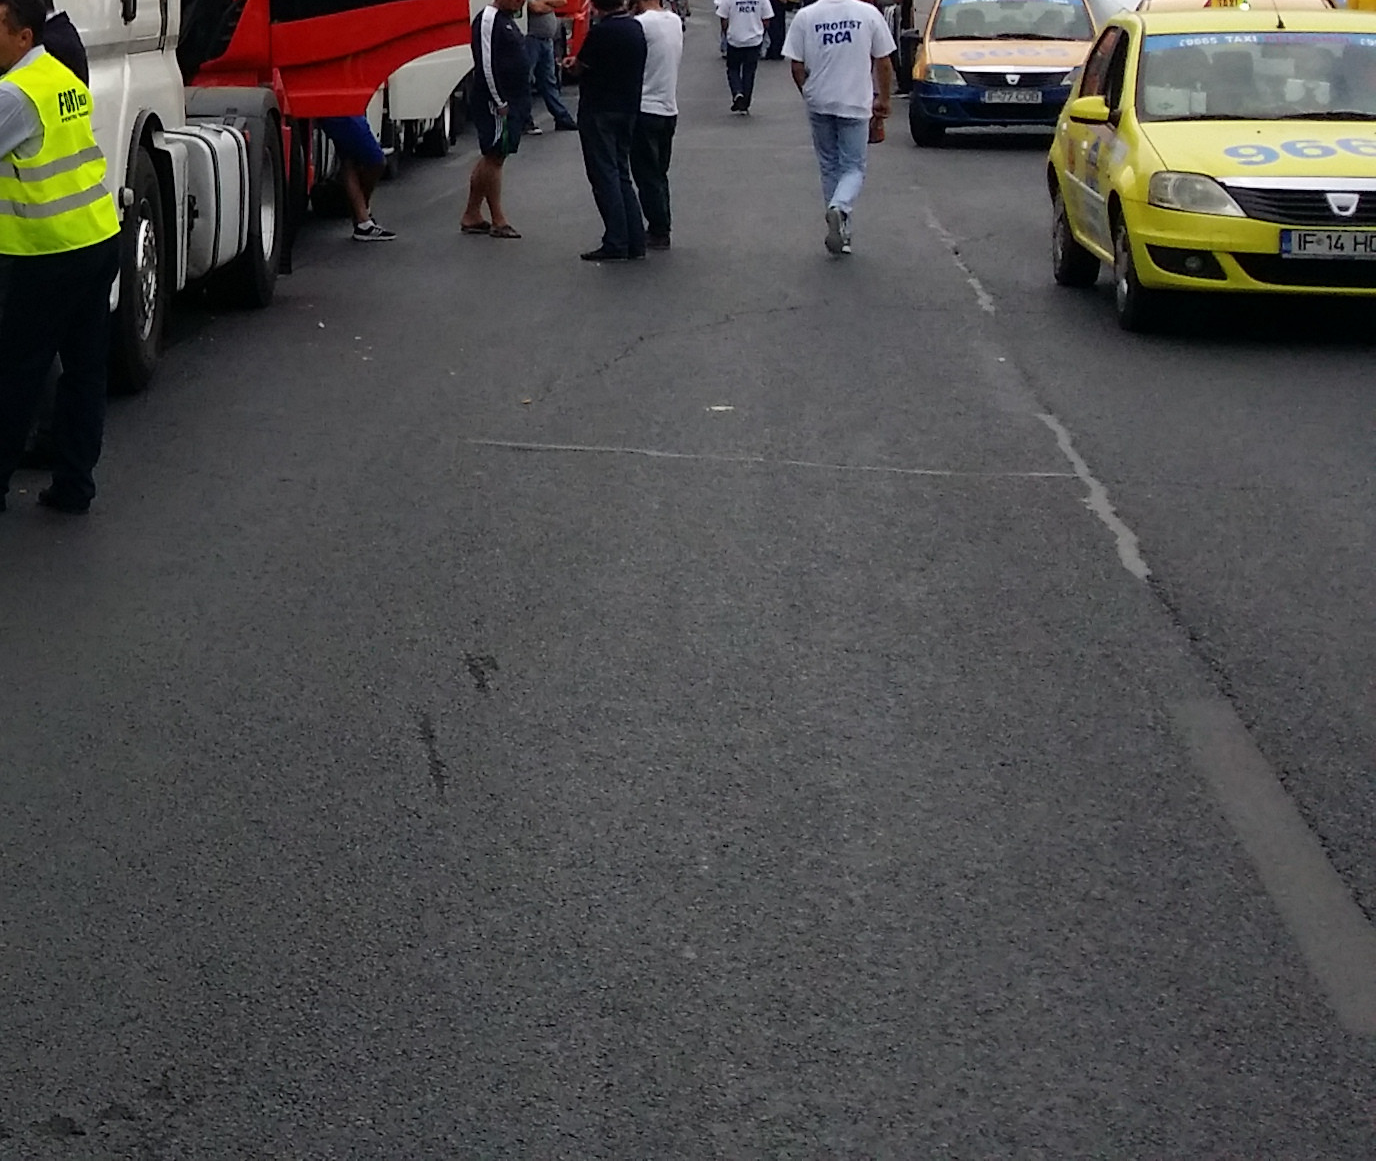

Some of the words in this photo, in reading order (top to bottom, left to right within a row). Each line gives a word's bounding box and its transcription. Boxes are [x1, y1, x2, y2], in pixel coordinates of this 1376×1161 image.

[738, 6, 756, 14] RCA
[814, 20, 863, 33] PROTEST
[822, 30, 852, 46] RCA
[1224, 35, 1258, 44] TAXI
[1298, 233, 1317, 250] IF
[1326, 234, 1345, 251] 14
